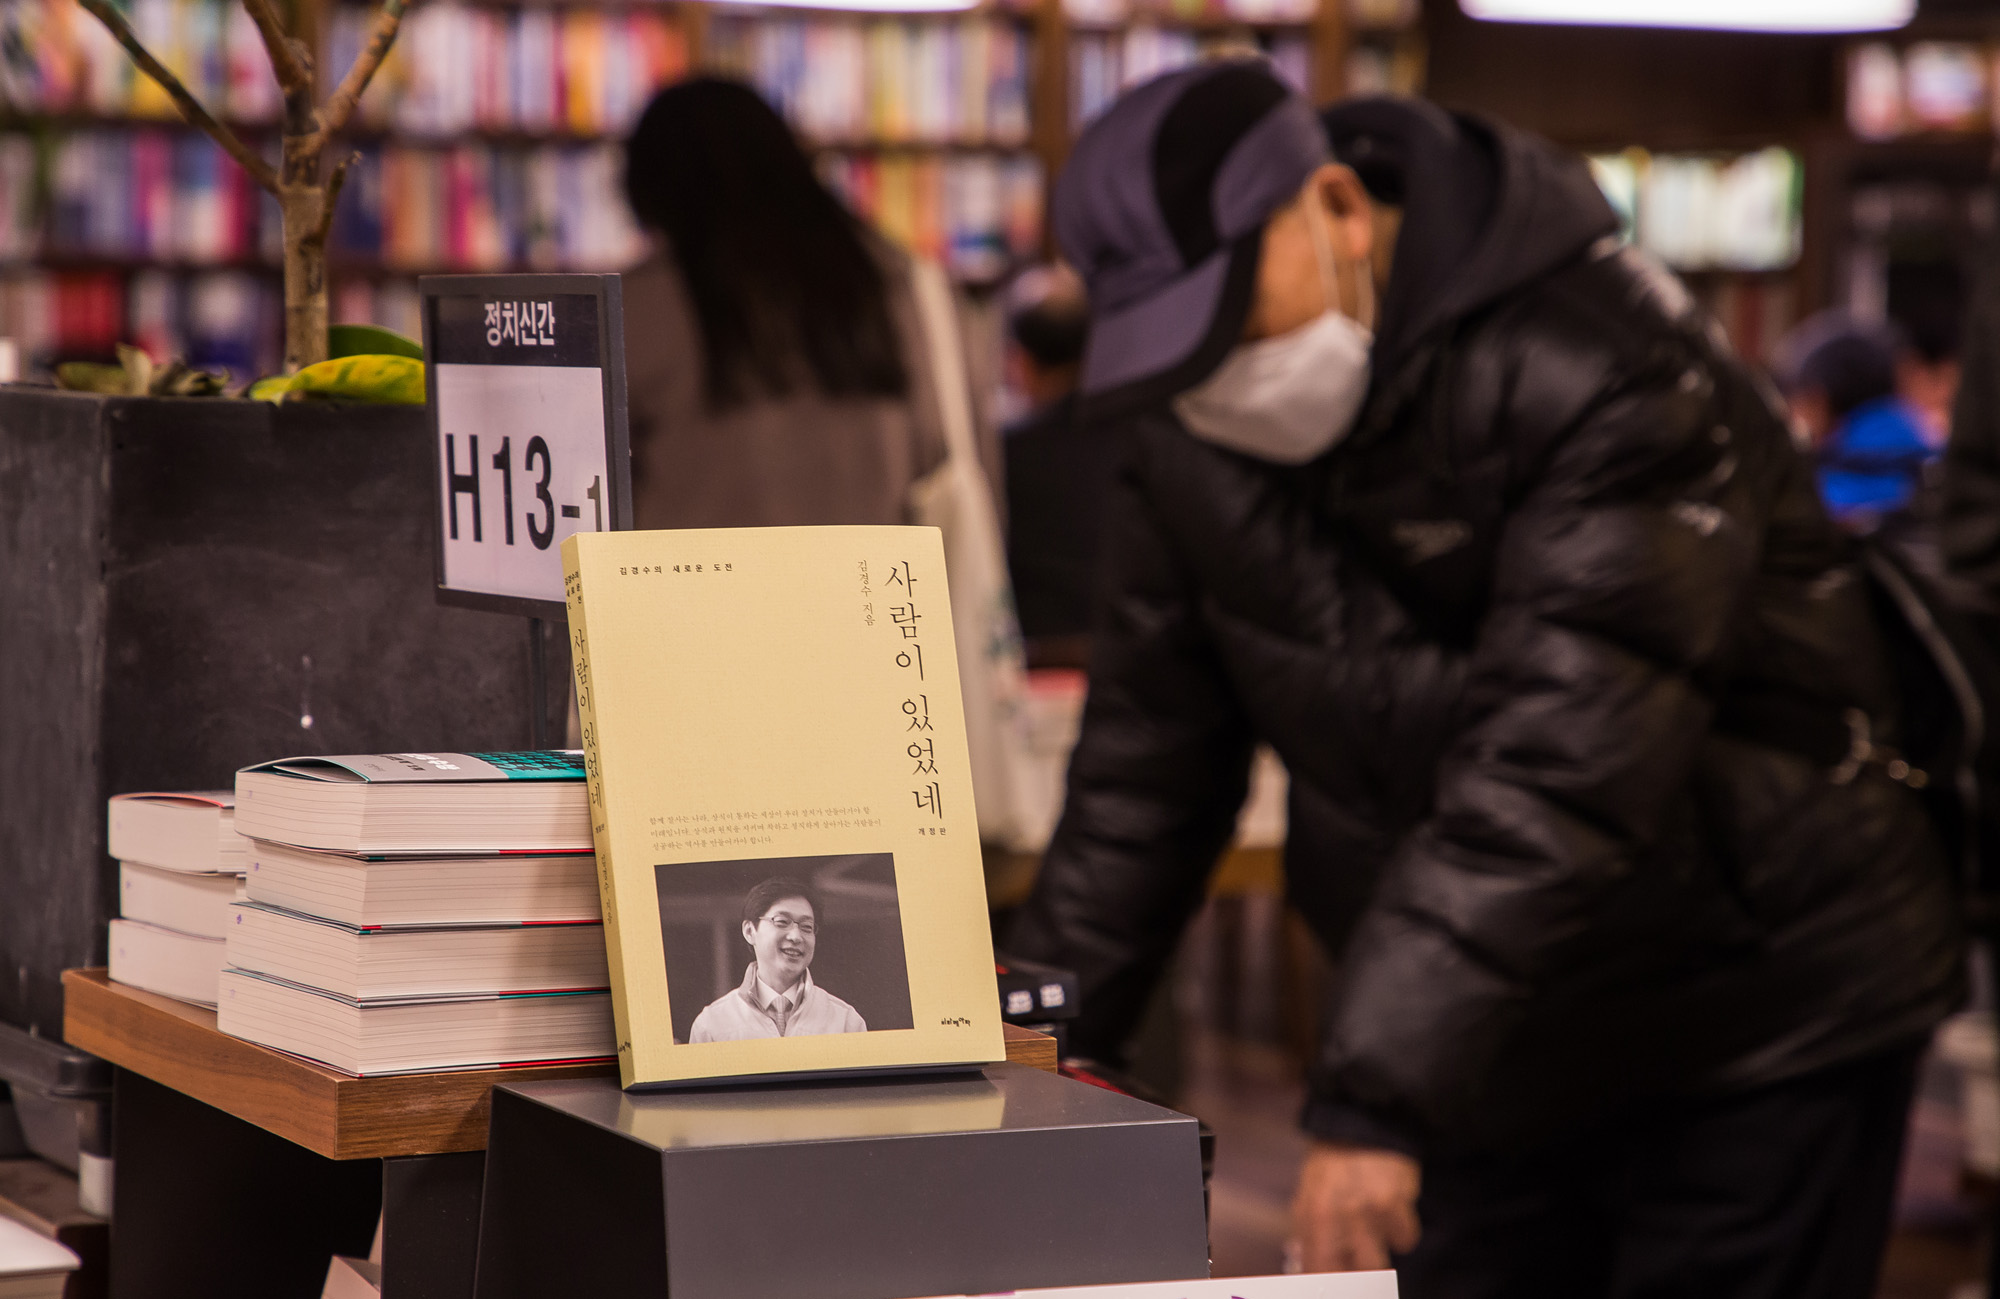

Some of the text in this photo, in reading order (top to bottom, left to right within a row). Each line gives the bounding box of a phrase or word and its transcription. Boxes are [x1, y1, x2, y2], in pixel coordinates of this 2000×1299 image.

[484, 301, 556, 346] 정치신간
[619, 562, 734, 576] 김경수의 새로운 도전
[857, 559, 876, 627] 김경수 지음
[884, 560, 943, 820] 사람이 있었네
[574, 628, 603, 809] 사람이 있었네
[918, 827, 947, 837] 개정판
